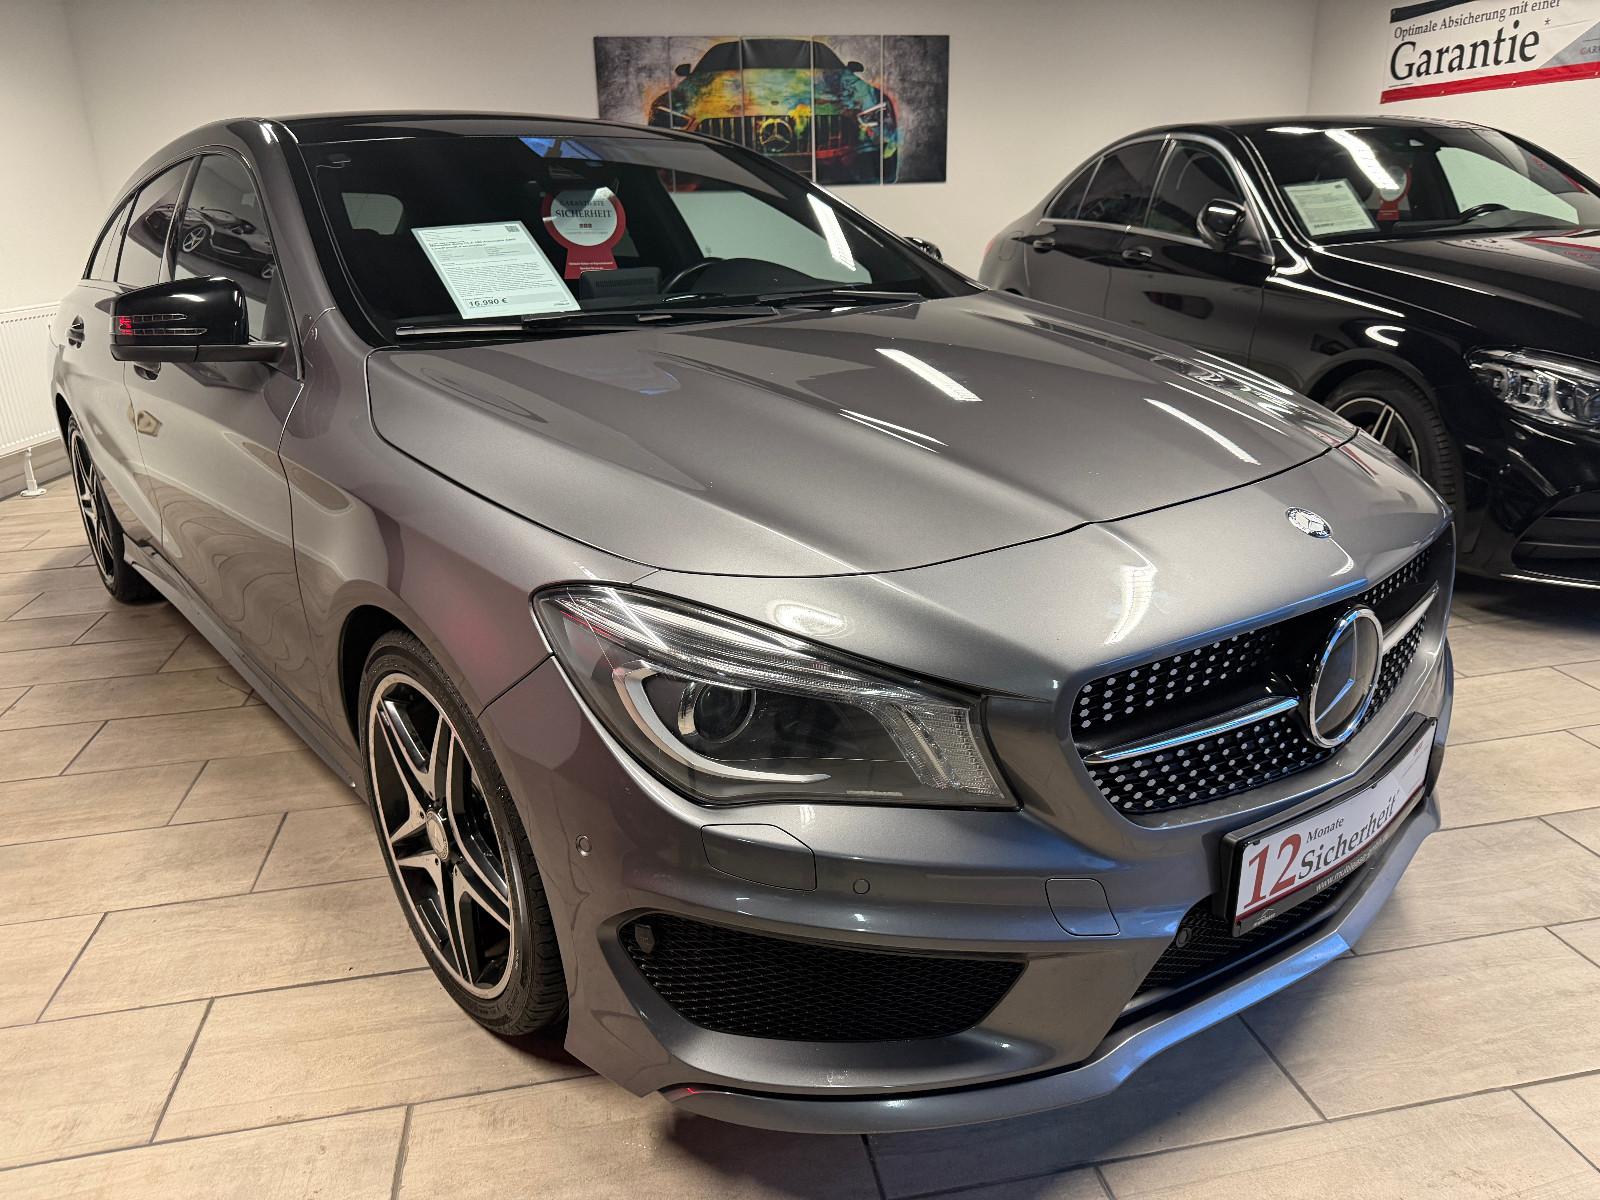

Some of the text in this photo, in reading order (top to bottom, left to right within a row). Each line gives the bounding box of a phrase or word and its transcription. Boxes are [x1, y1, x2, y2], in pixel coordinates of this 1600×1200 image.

[1390, 19, 1540, 80] Garantie
[1394, 20, 1437, 41] Optimale
[1440, 8, 1506, 30] Absicherung
[1509, 1, 1528, 16] mit
[555, 209, 612, 218] SICHERHEIT
[1243, 816, 1345, 910] 12 Monate
[1298, 797, 1396, 880] Sicherheit
